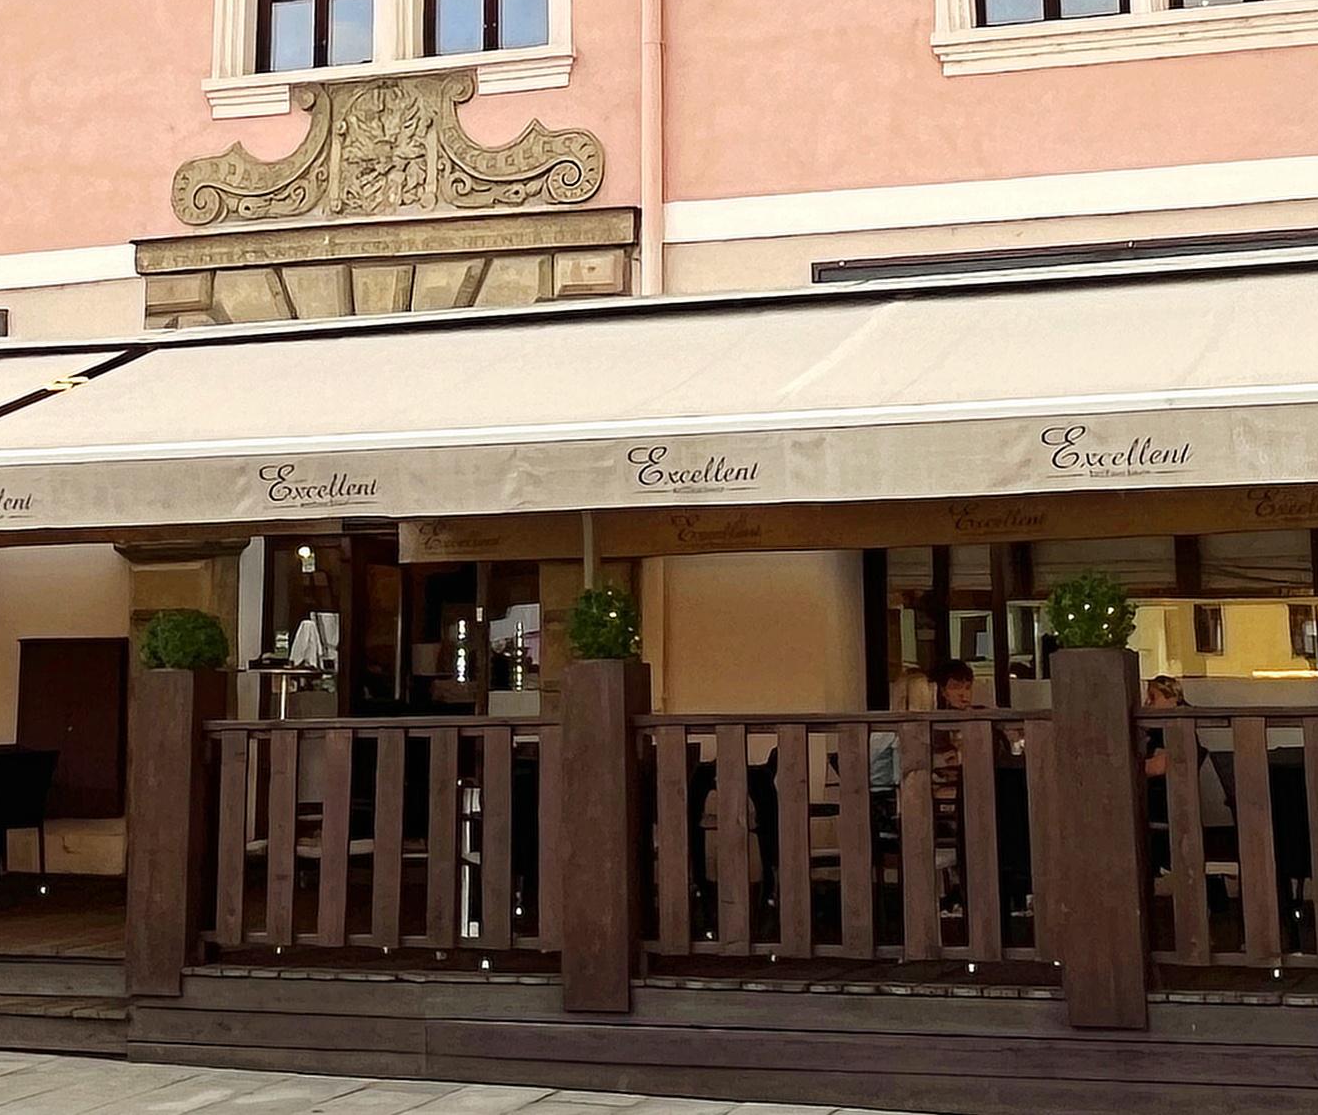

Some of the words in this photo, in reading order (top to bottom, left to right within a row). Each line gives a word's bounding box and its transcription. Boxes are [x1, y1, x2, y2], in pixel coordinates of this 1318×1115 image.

[627, 446, 758, 486] Excellent
[1040, 424, 1194, 469] Excellent
[259, 463, 378, 502] Excellent
